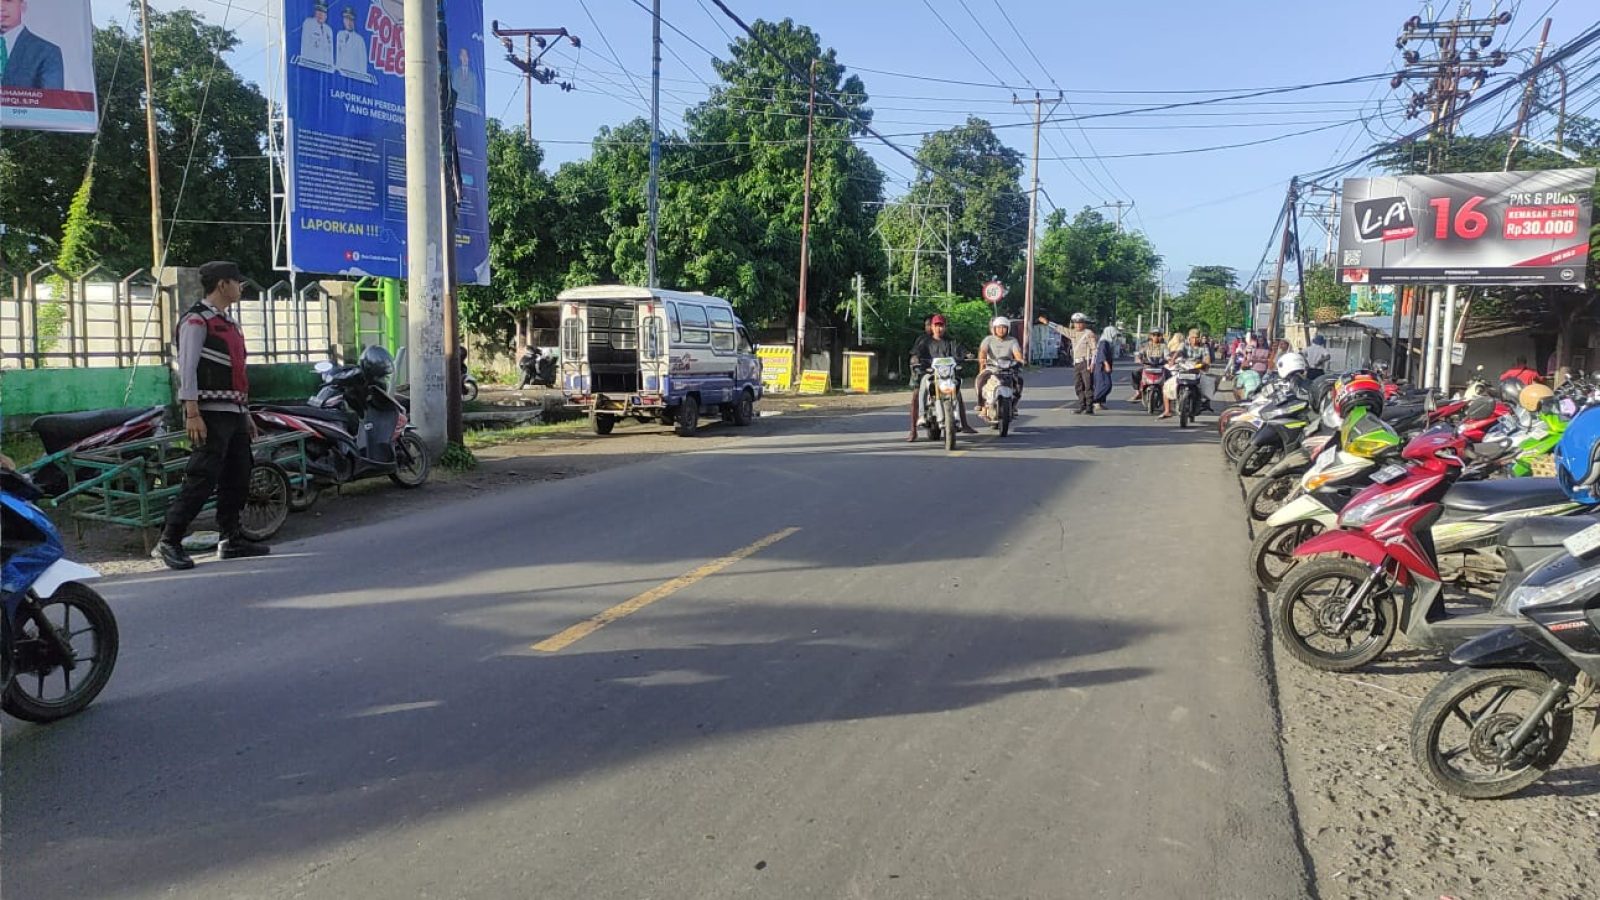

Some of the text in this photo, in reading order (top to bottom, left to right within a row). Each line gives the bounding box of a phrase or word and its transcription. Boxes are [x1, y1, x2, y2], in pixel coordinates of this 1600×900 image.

[366, 5, 405, 50] ROK
[330, 89, 373, 106] LAPORKAN
[344, 103, 369, 116] YANG
[1510, 193, 1531, 205] PAS
[1534, 192, 1543, 205] &
[1429, 196, 1488, 240] 16
[301, 217, 379, 237] LAPORKAN !!!
[1507, 220, 1574, 237] Rp30.000
[1551, 620, 1588, 632] HONDA
